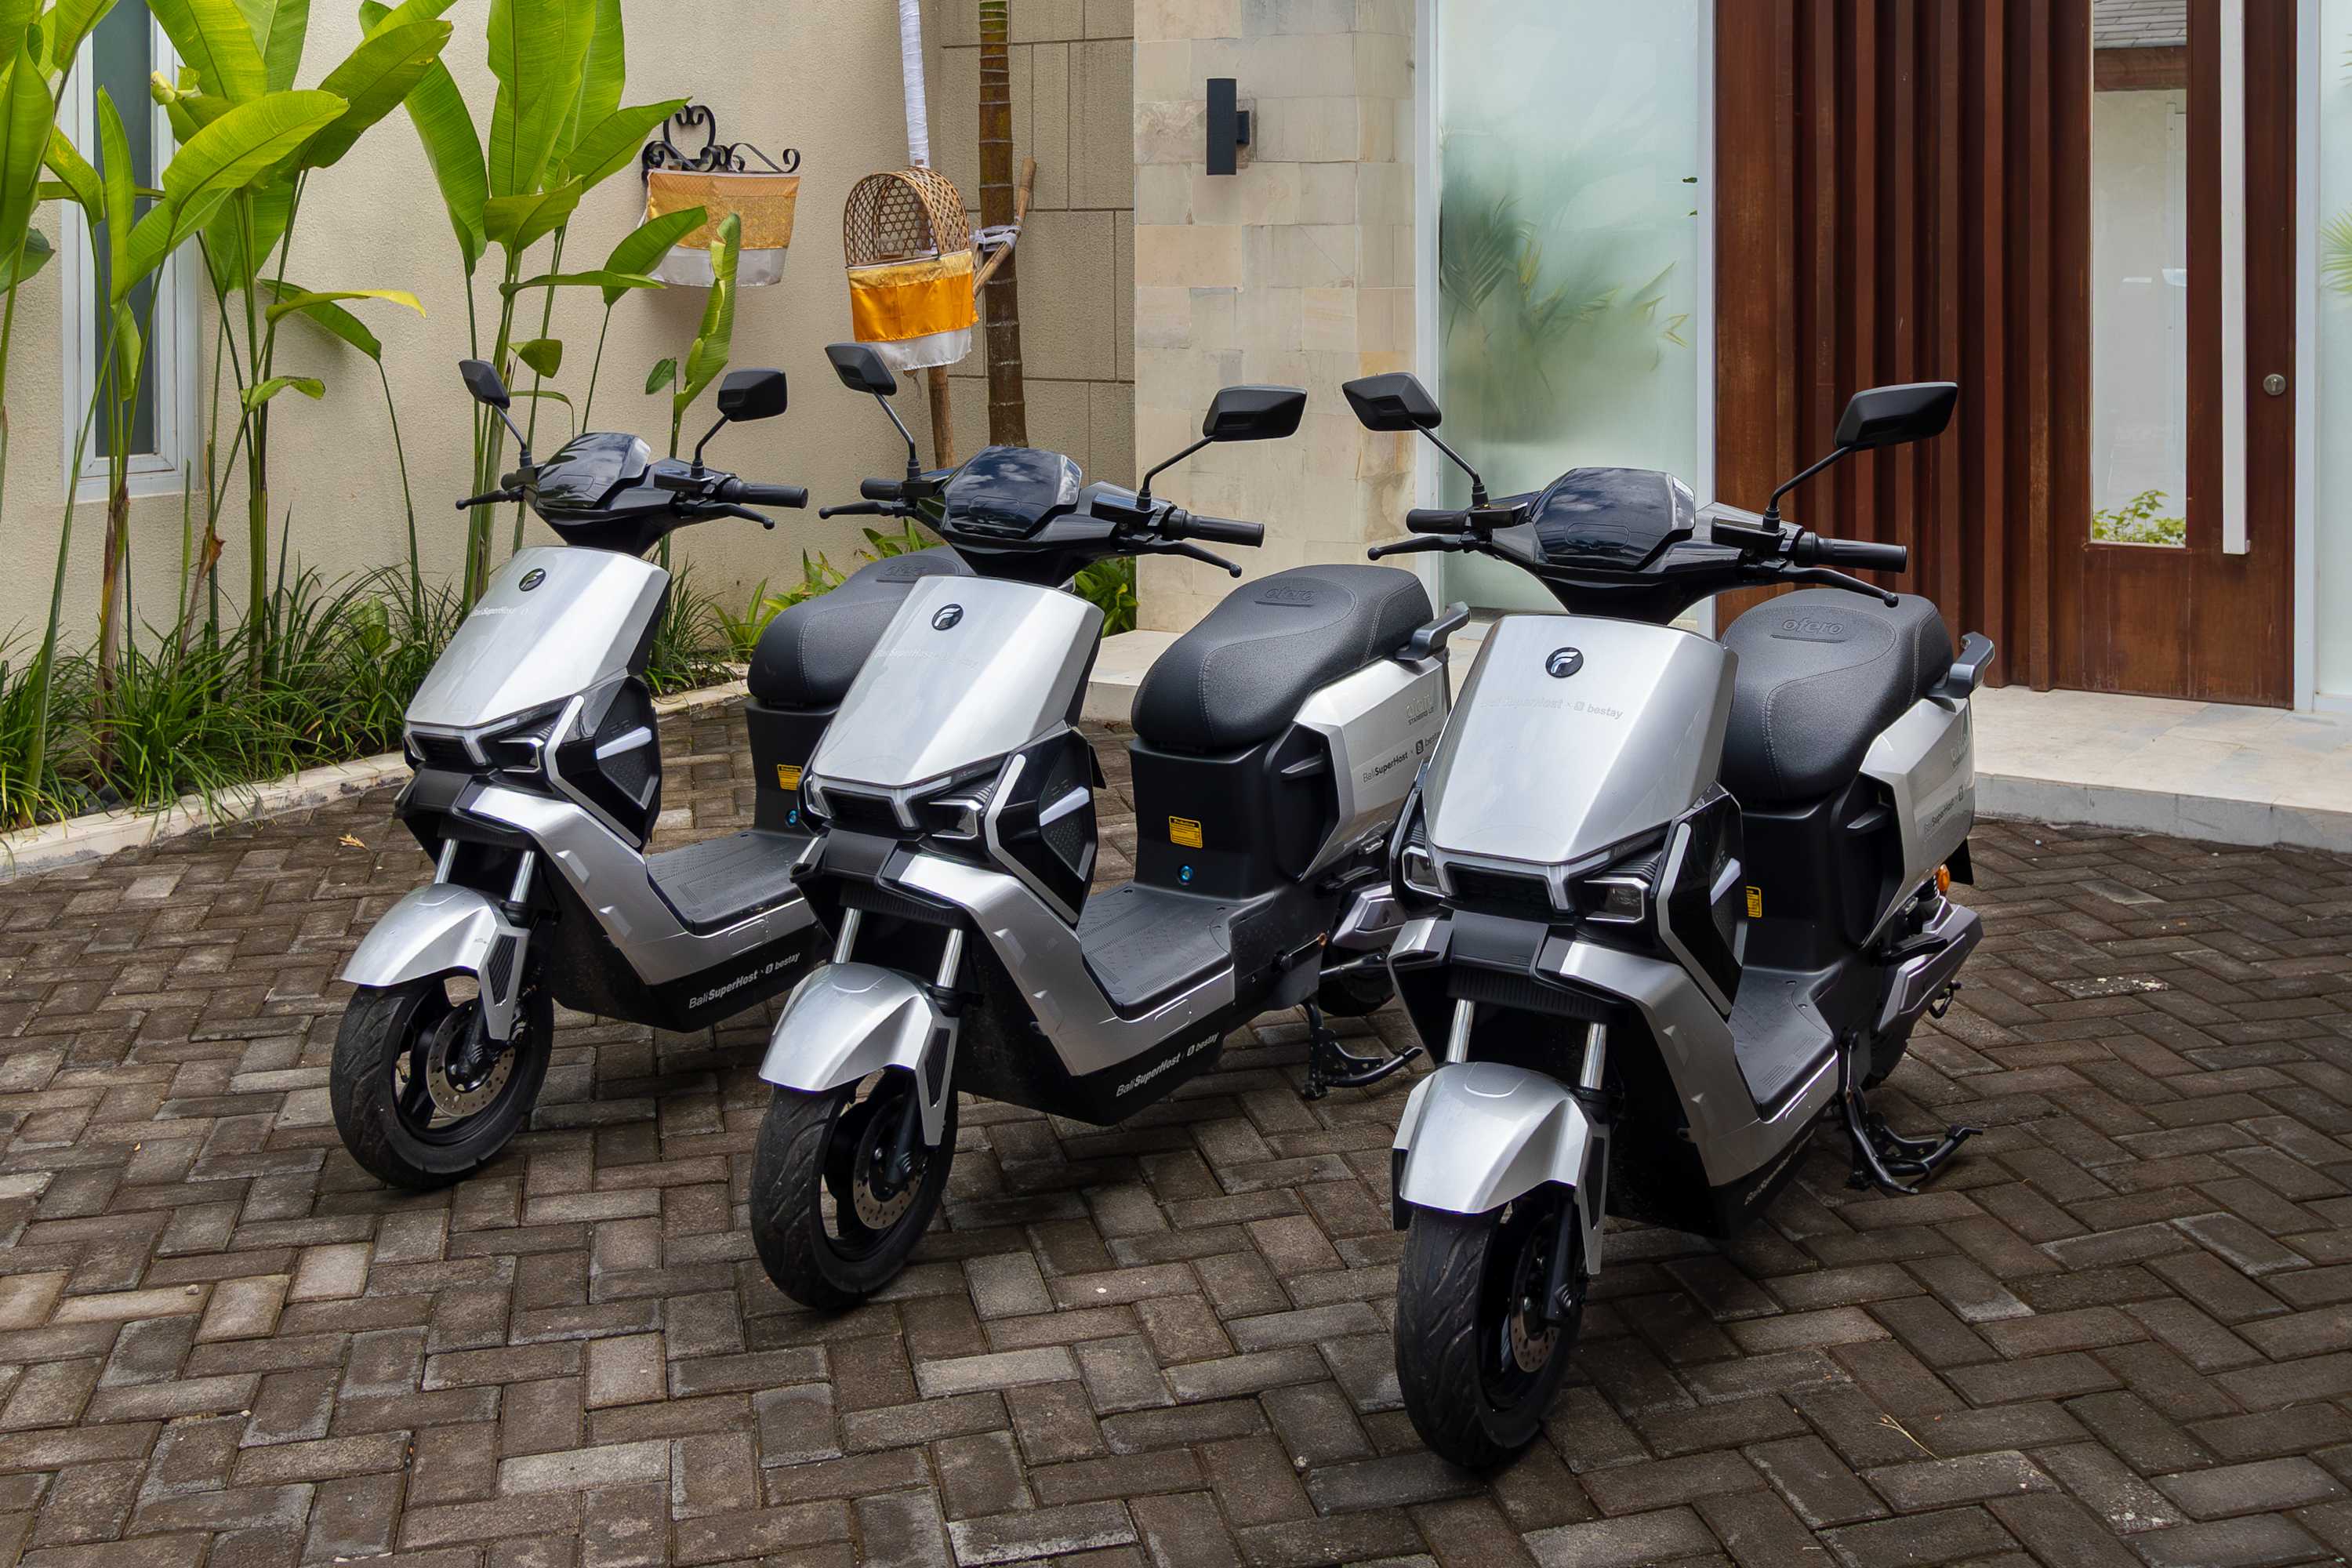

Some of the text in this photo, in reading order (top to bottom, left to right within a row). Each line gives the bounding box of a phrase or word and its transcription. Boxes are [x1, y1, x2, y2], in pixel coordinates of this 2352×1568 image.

[1781, 617, 1845, 635] ofero
[1587, 702, 1624, 720] bestay
[1425, 729, 1443, 748] best
[688, 970, 759, 1010] BaliSuperHost
[1116, 1052, 1181, 1098] BaliSuperHost
